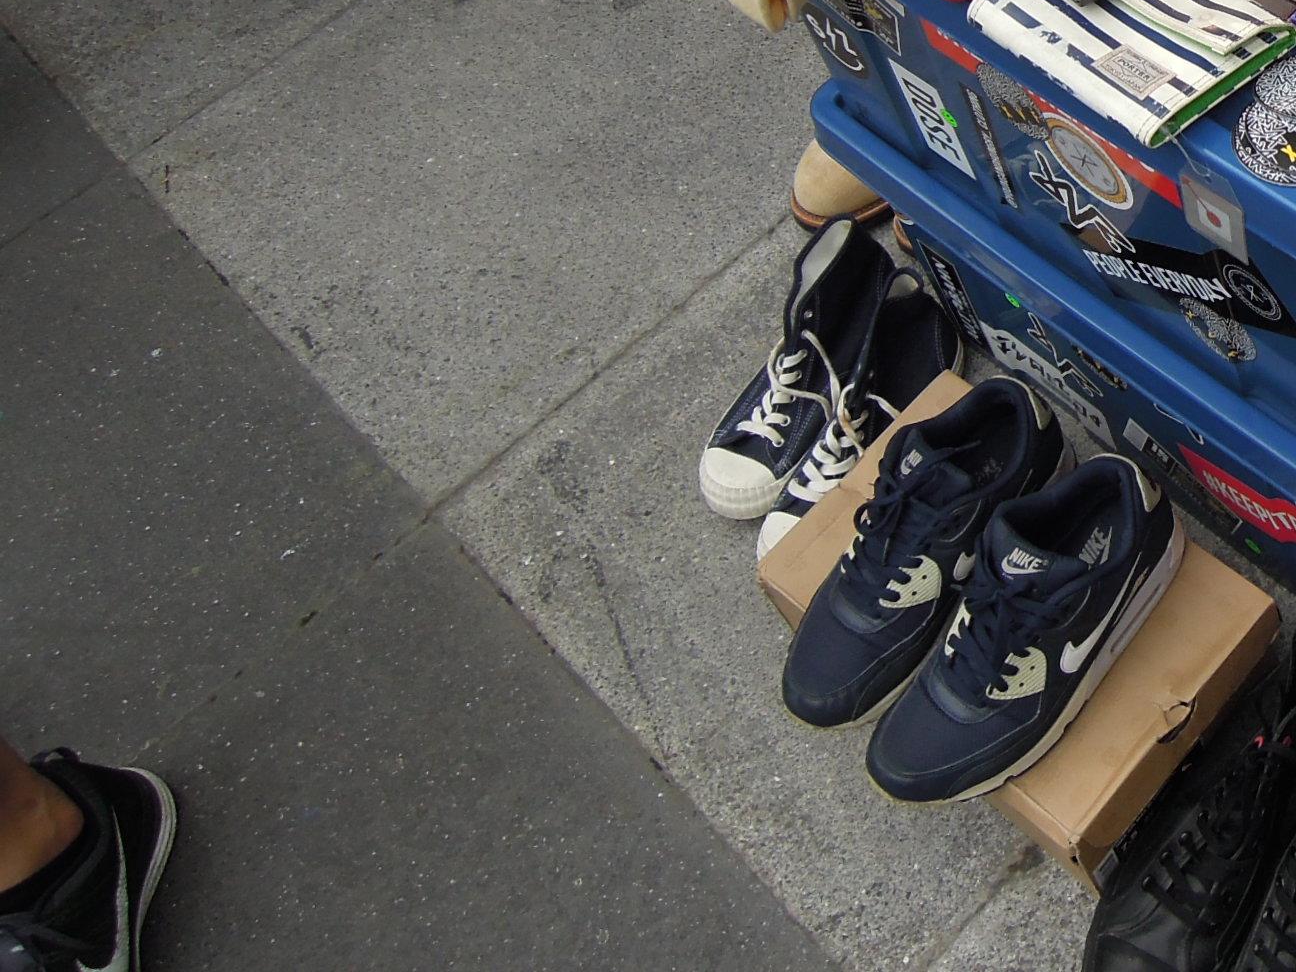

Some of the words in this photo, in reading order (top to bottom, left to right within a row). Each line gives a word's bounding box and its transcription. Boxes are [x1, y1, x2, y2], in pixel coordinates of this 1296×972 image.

[1117, 58, 1150, 81] PORTER
[902, 77, 961, 161] DOSE
[1082, 249, 1149, 285] PEOPLE
[1136, 261, 1232, 303] EVERYDAY
[1008, 547, 1042, 571] NIKE
[1078, 527, 1108, 568] NIKE
